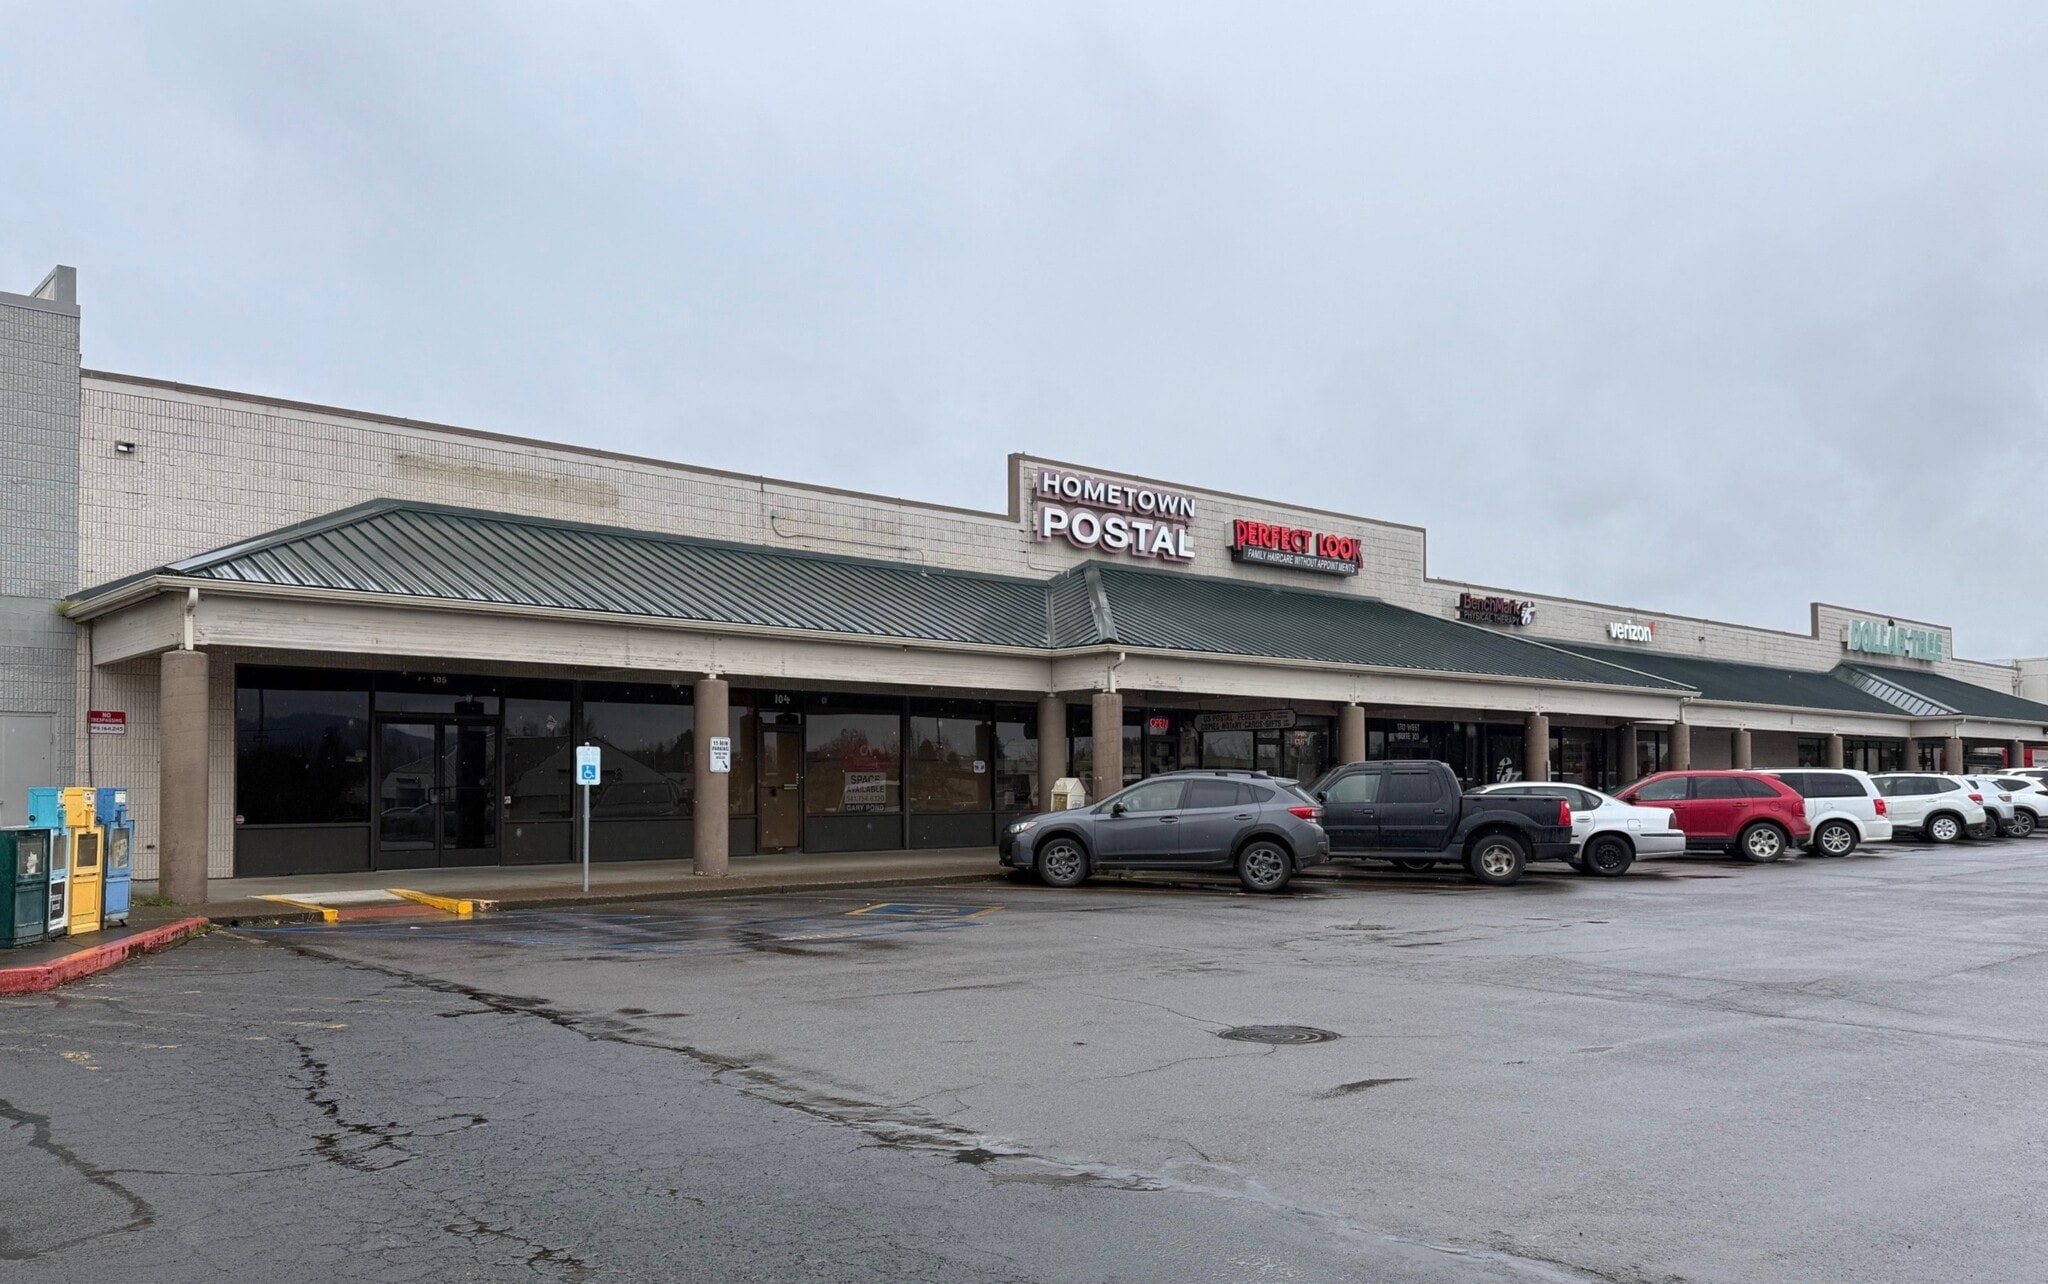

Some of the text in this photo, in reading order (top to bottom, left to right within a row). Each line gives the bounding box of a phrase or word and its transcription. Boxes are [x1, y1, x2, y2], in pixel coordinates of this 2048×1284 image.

[1042, 472, 1195, 518] HOMETOWN
[1042, 506, 1196, 558] POSTAL
[1233, 519, 1363, 568] PERFECT LOOK
[1247, 548, 1267, 560] FAMILY
[1267, 550, 1294, 565] HAIRCARE
[1294, 555, 1317, 568] WITHOUT
[1462, 592, 1520, 615] BenchMark
[1463, 610, 1520, 625] PHYSICAL THERAPY
[1610, 619, 1652, 642] verizon
[1850, 619, 1943, 663] DOLLAR TREE
[432, 676, 447, 684] 105
[775, 694, 791, 704] 104
[1150, 717, 1169, 729] OPEN
[846, 785, 885, 793] AVAILABLE
[850, 774, 881, 785] SPACE
